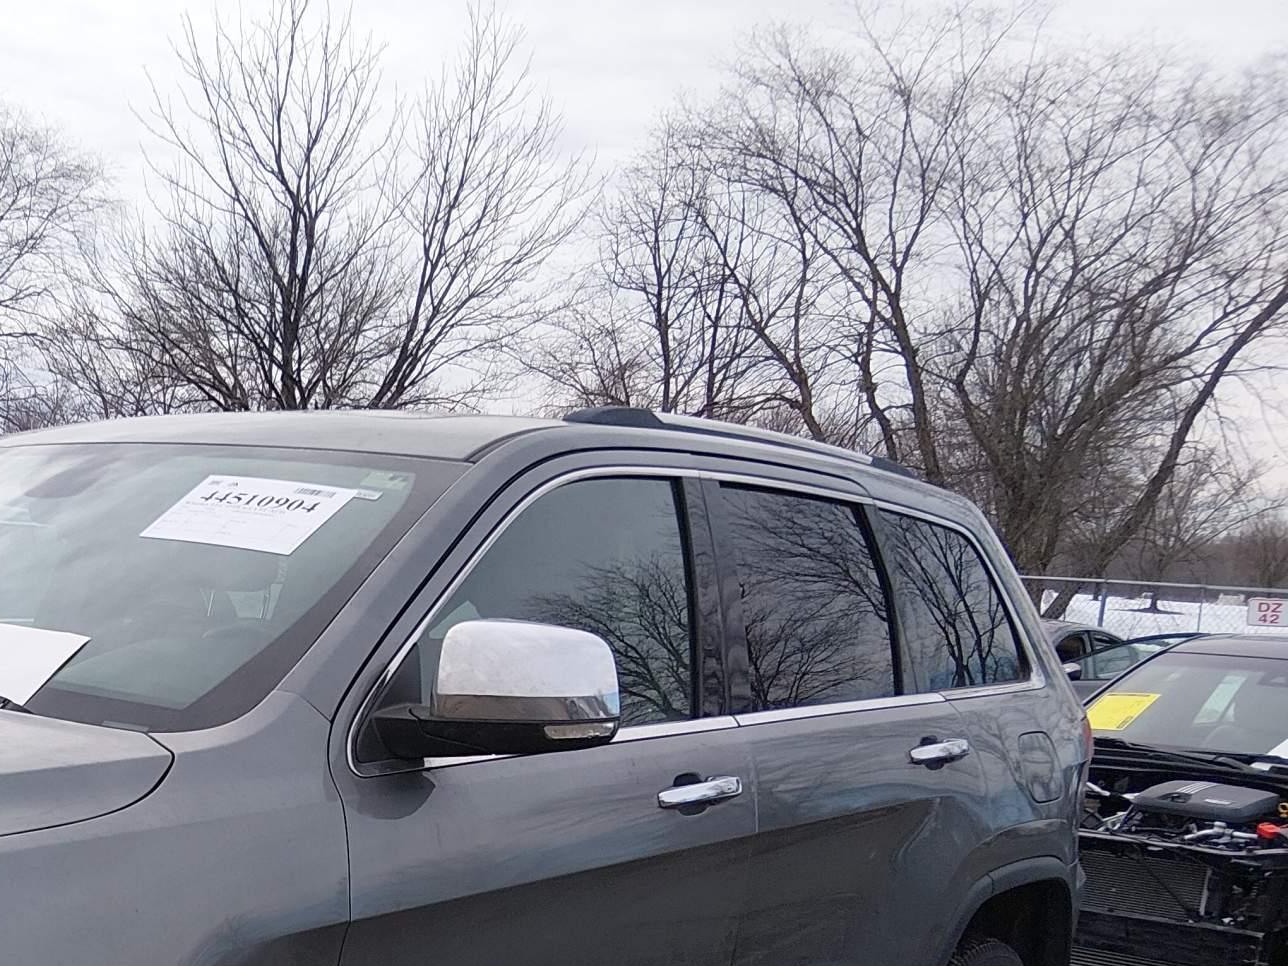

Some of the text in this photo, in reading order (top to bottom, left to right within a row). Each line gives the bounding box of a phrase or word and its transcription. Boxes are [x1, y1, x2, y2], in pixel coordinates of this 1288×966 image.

[200, 490, 321, 513] 44510904
[1258, 602, 1282, 613] DZ
[1258, 614, 1280, 624] 42
